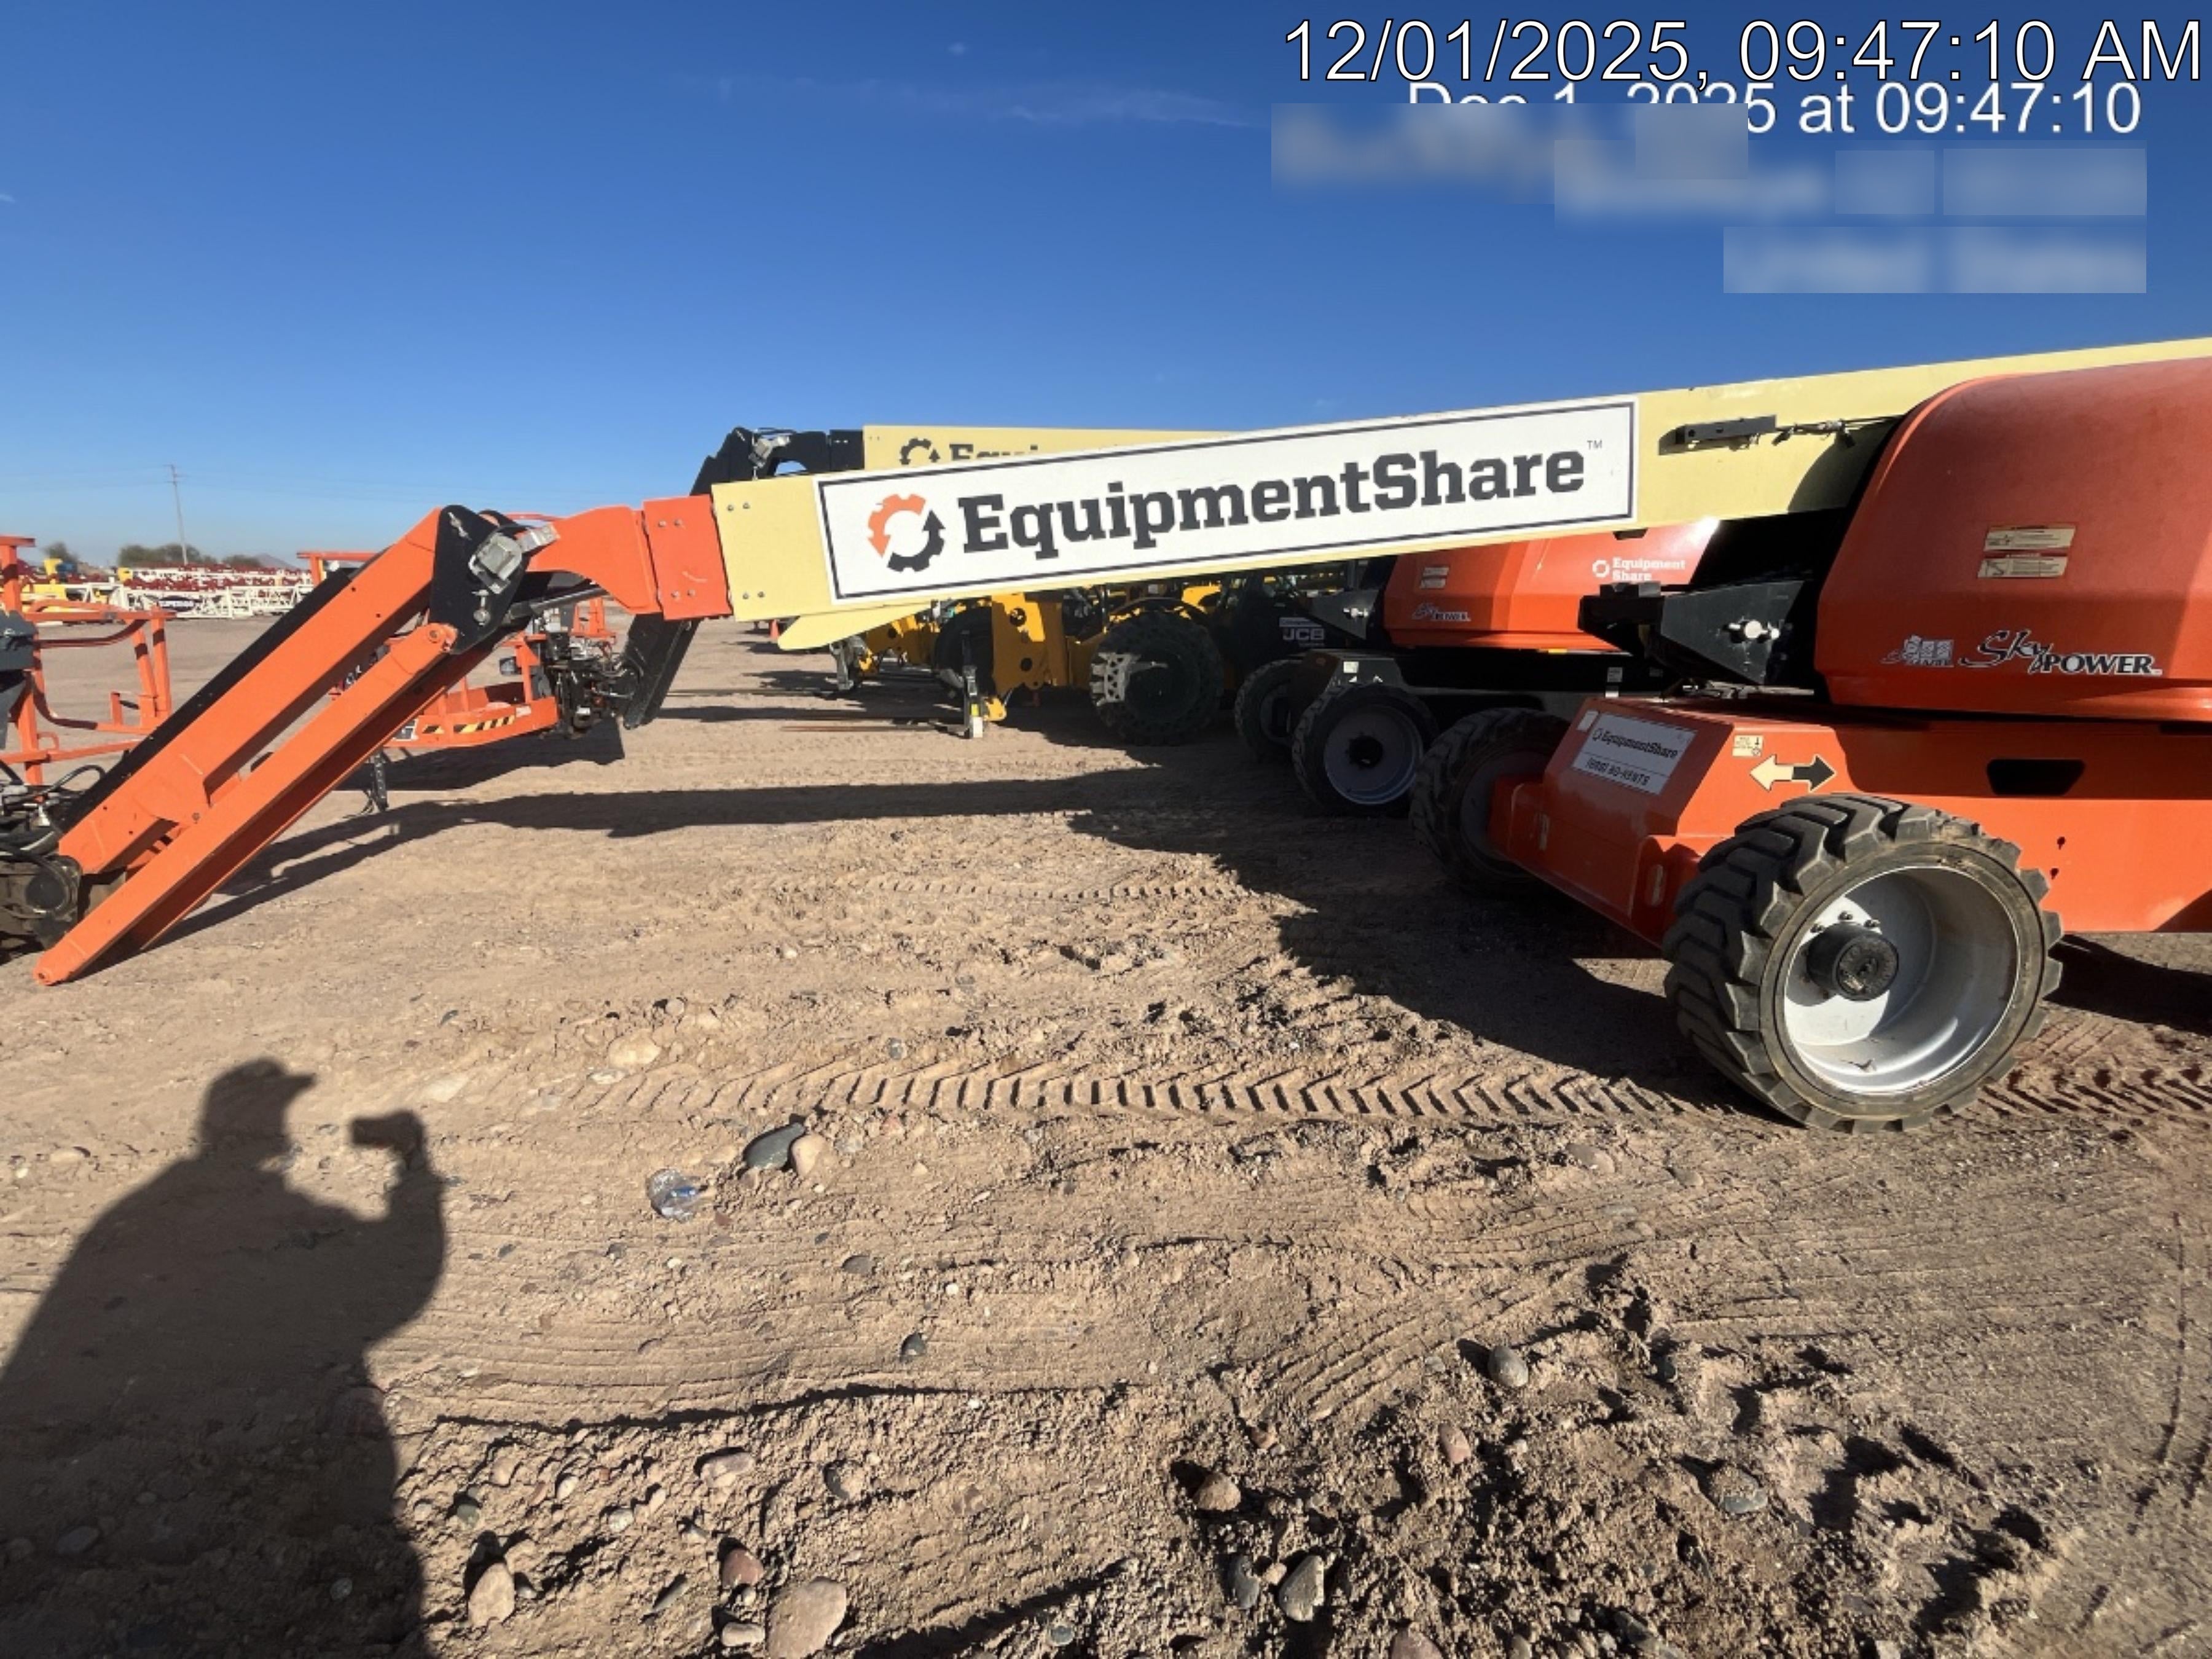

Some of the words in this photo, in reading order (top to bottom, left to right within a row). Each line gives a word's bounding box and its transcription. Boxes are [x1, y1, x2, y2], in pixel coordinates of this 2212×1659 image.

[957, 449, 1584, 559] EquipmentShare
[1612, 557, 1686, 570] Equipment
[1612, 570, 1652, 581] Share
[1282, 628, 1325, 640] JCB
[1601, 728, 1679, 759] EquipmentShare
